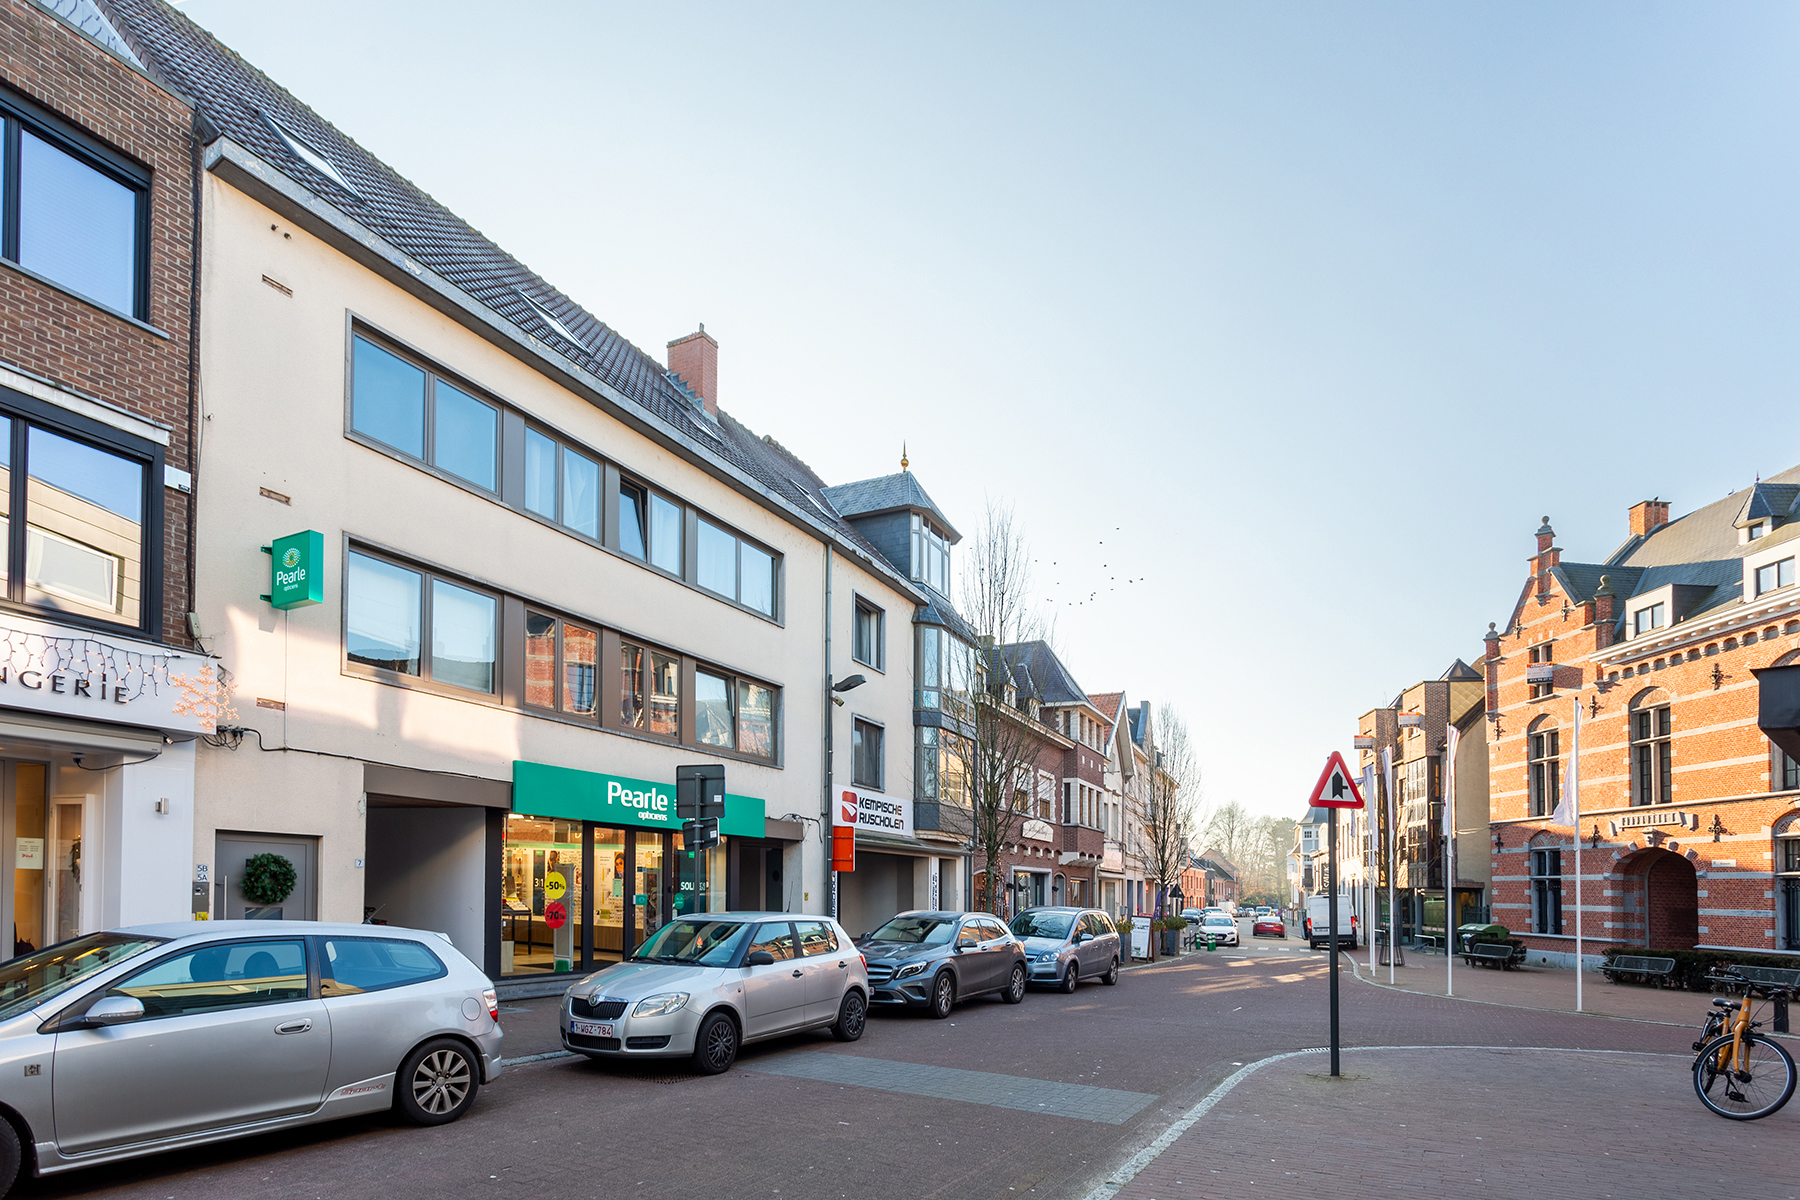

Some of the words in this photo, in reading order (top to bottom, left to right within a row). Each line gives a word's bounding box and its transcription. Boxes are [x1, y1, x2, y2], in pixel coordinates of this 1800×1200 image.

[277, 567, 305, 586] Pearle
[607, 781, 668, 811] Pearle
[859, 797, 902, 816] KEMPISCHE
[859, 812, 904, 830] RIJSCHOLEN
[197, 864, 208, 872] 5B
[197, 873, 208, 881] 5A
[546, 881, 566, 891] -50%
[546, 910, 566, 920] -70%
[575, 1023, 611, 1036] 1-WGZ-784
